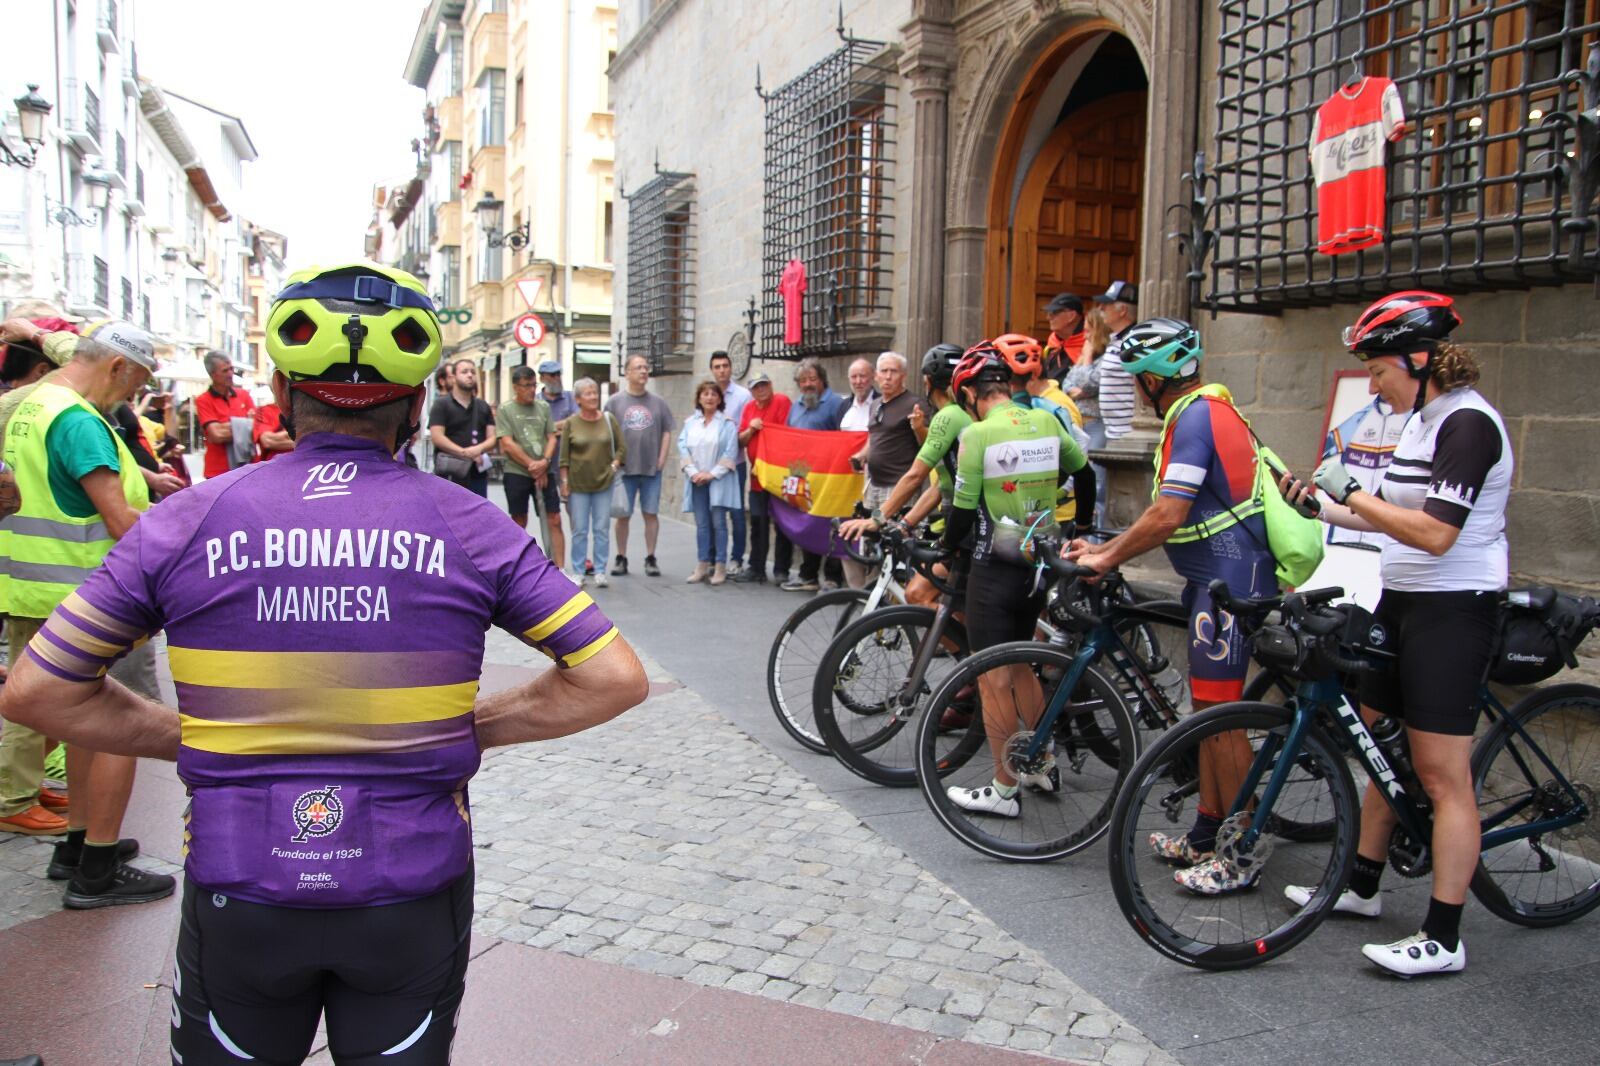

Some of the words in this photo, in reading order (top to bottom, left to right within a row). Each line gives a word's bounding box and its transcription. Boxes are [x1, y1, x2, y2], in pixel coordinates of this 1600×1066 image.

[1021, 446, 1054, 457] RENAULT
[302, 461, 358, 492] 100
[256, 585, 391, 622] MANRESA
[1337, 693, 1406, 799] TREK
[271, 847, 320, 860] Fundada
[322, 849, 333, 860] el
[336, 847, 363, 860] 1926
[300, 872, 332, 882] tactic
[296, 880, 339, 891] projects
